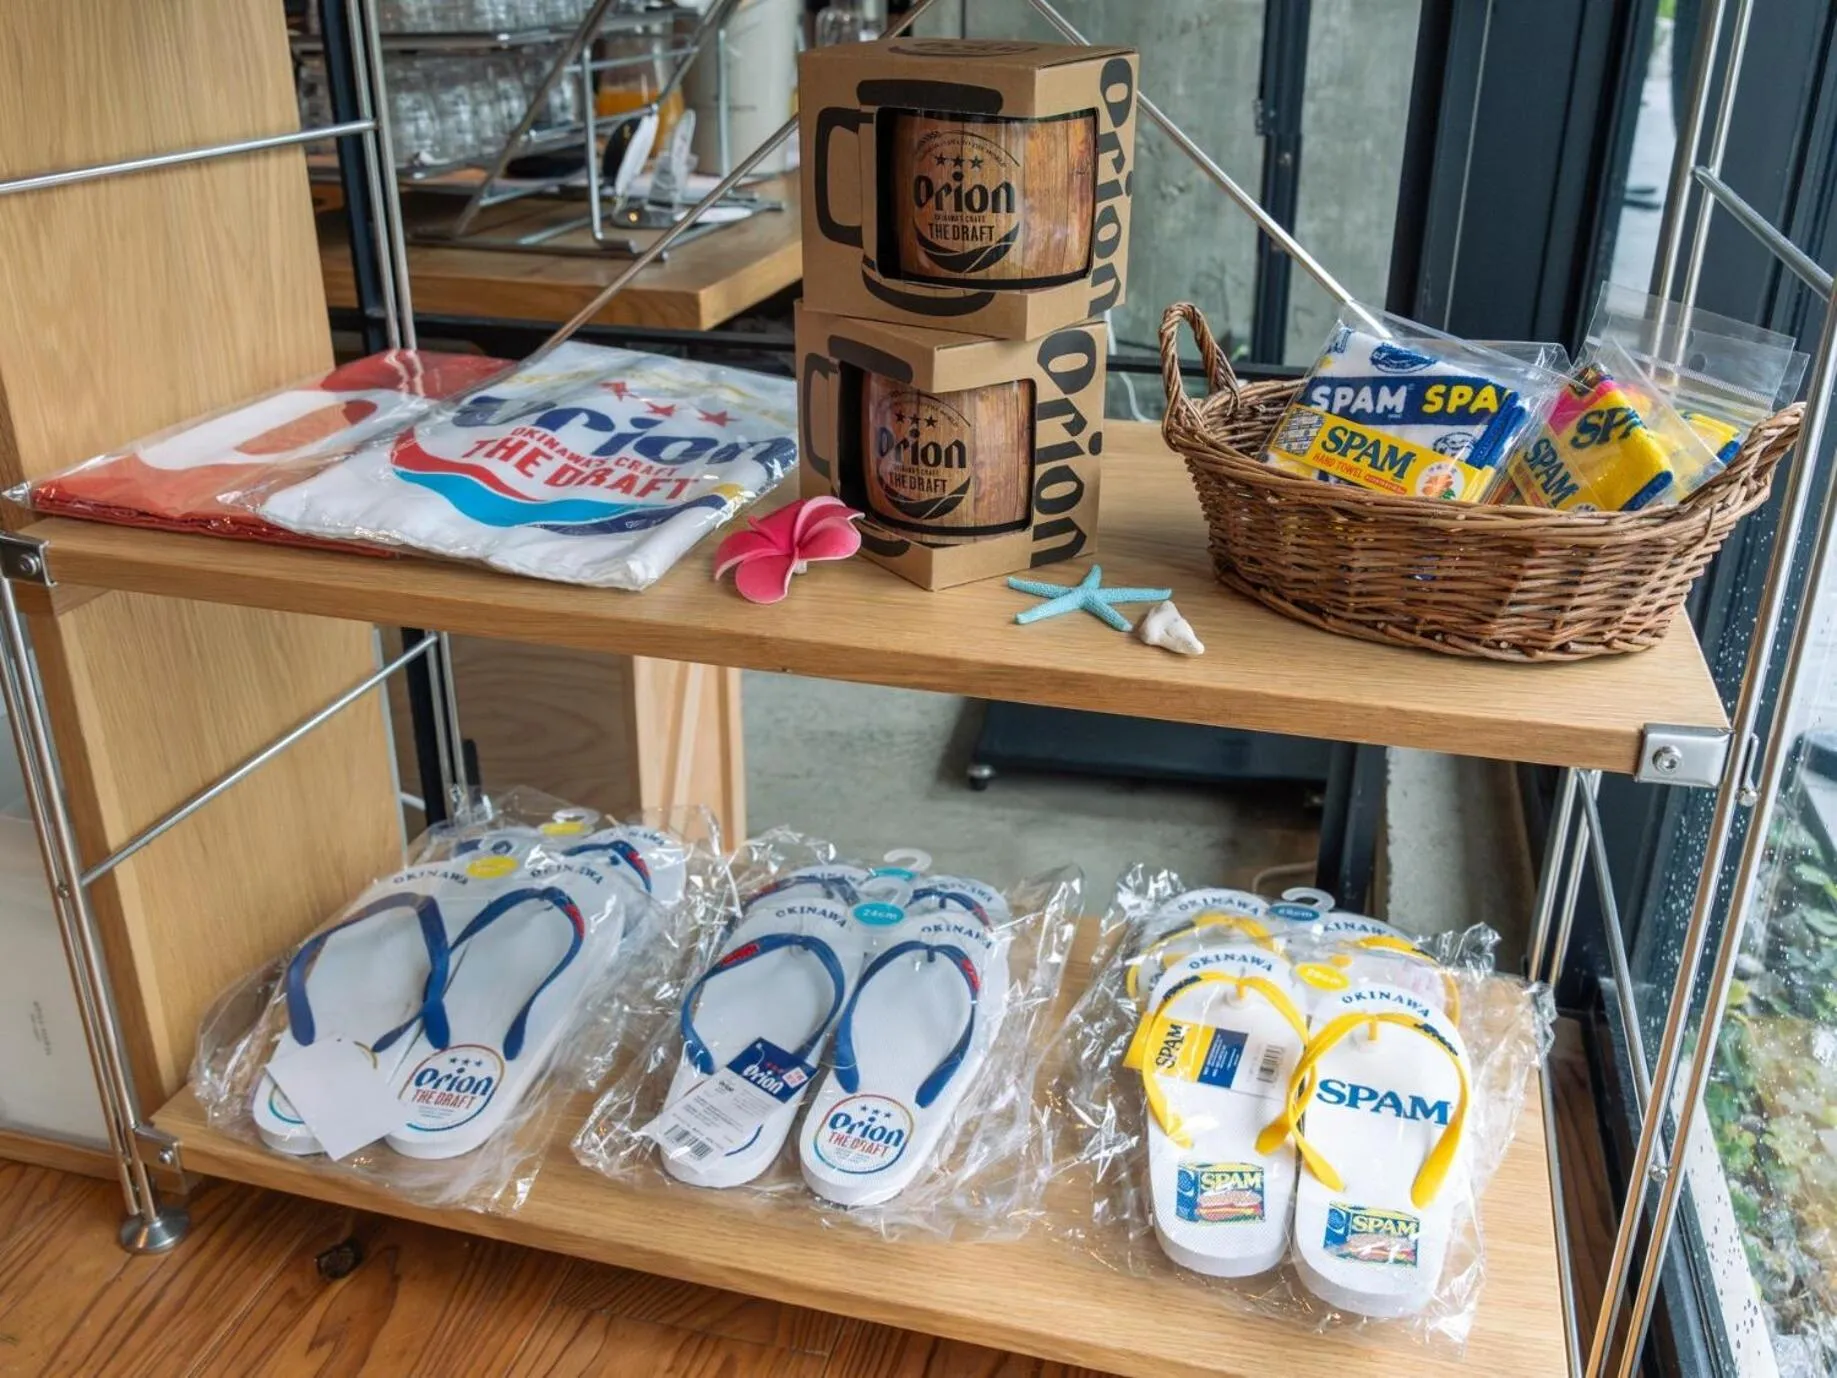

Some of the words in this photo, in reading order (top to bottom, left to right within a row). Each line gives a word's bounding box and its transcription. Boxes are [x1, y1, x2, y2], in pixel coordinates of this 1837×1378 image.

[914, 171, 1015, 213] Orion
[1087, 57, 1133, 318] Orion
[928, 223, 949, 240] THE
[952, 225, 994, 242] DRAFT
[1311, 383, 1408, 415] SPAM
[1422, 383, 1511, 415] SPA
[876, 427, 966, 468] Orion
[1030, 329, 1102, 568] Orion
[1320, 425, 1417, 480] SPAM
[462, 436, 554, 479] THE
[544, 463, 699, 500] DRAFT
[613, 456, 681, 478] CRAFT
[1523, 437, 1580, 509] SPAM
[889, 472, 907, 489] THE
[909, 475, 948, 493] DRAFT
[392, 868, 469, 886] OKINAWA
[775, 904, 847, 928] OKINAWA
[1177, 897, 1259, 916] OKINAWA
[1323, 921, 1394, 938] KINAW
[1188, 952, 1274, 973] OKINAWA
[1341, 990, 1430, 1018] OKINAWA
[1154, 1023, 1185, 1069] SPAM
[414, 1067, 494, 1096] Orion
[742, 1064, 785, 1095] Orion
[412, 1088, 437, 1103] THE
[434, 1091, 477, 1110] DRAFT
[1316, 1078, 1451, 1126] SPAM
[828, 1112, 905, 1148] Orion
[828, 1131, 850, 1147] THE
[850, 1138, 889, 1158] DRAFT
[1201, 1171, 1263, 1191] SPAM
[1351, 1215, 1418, 1237] SPAM
